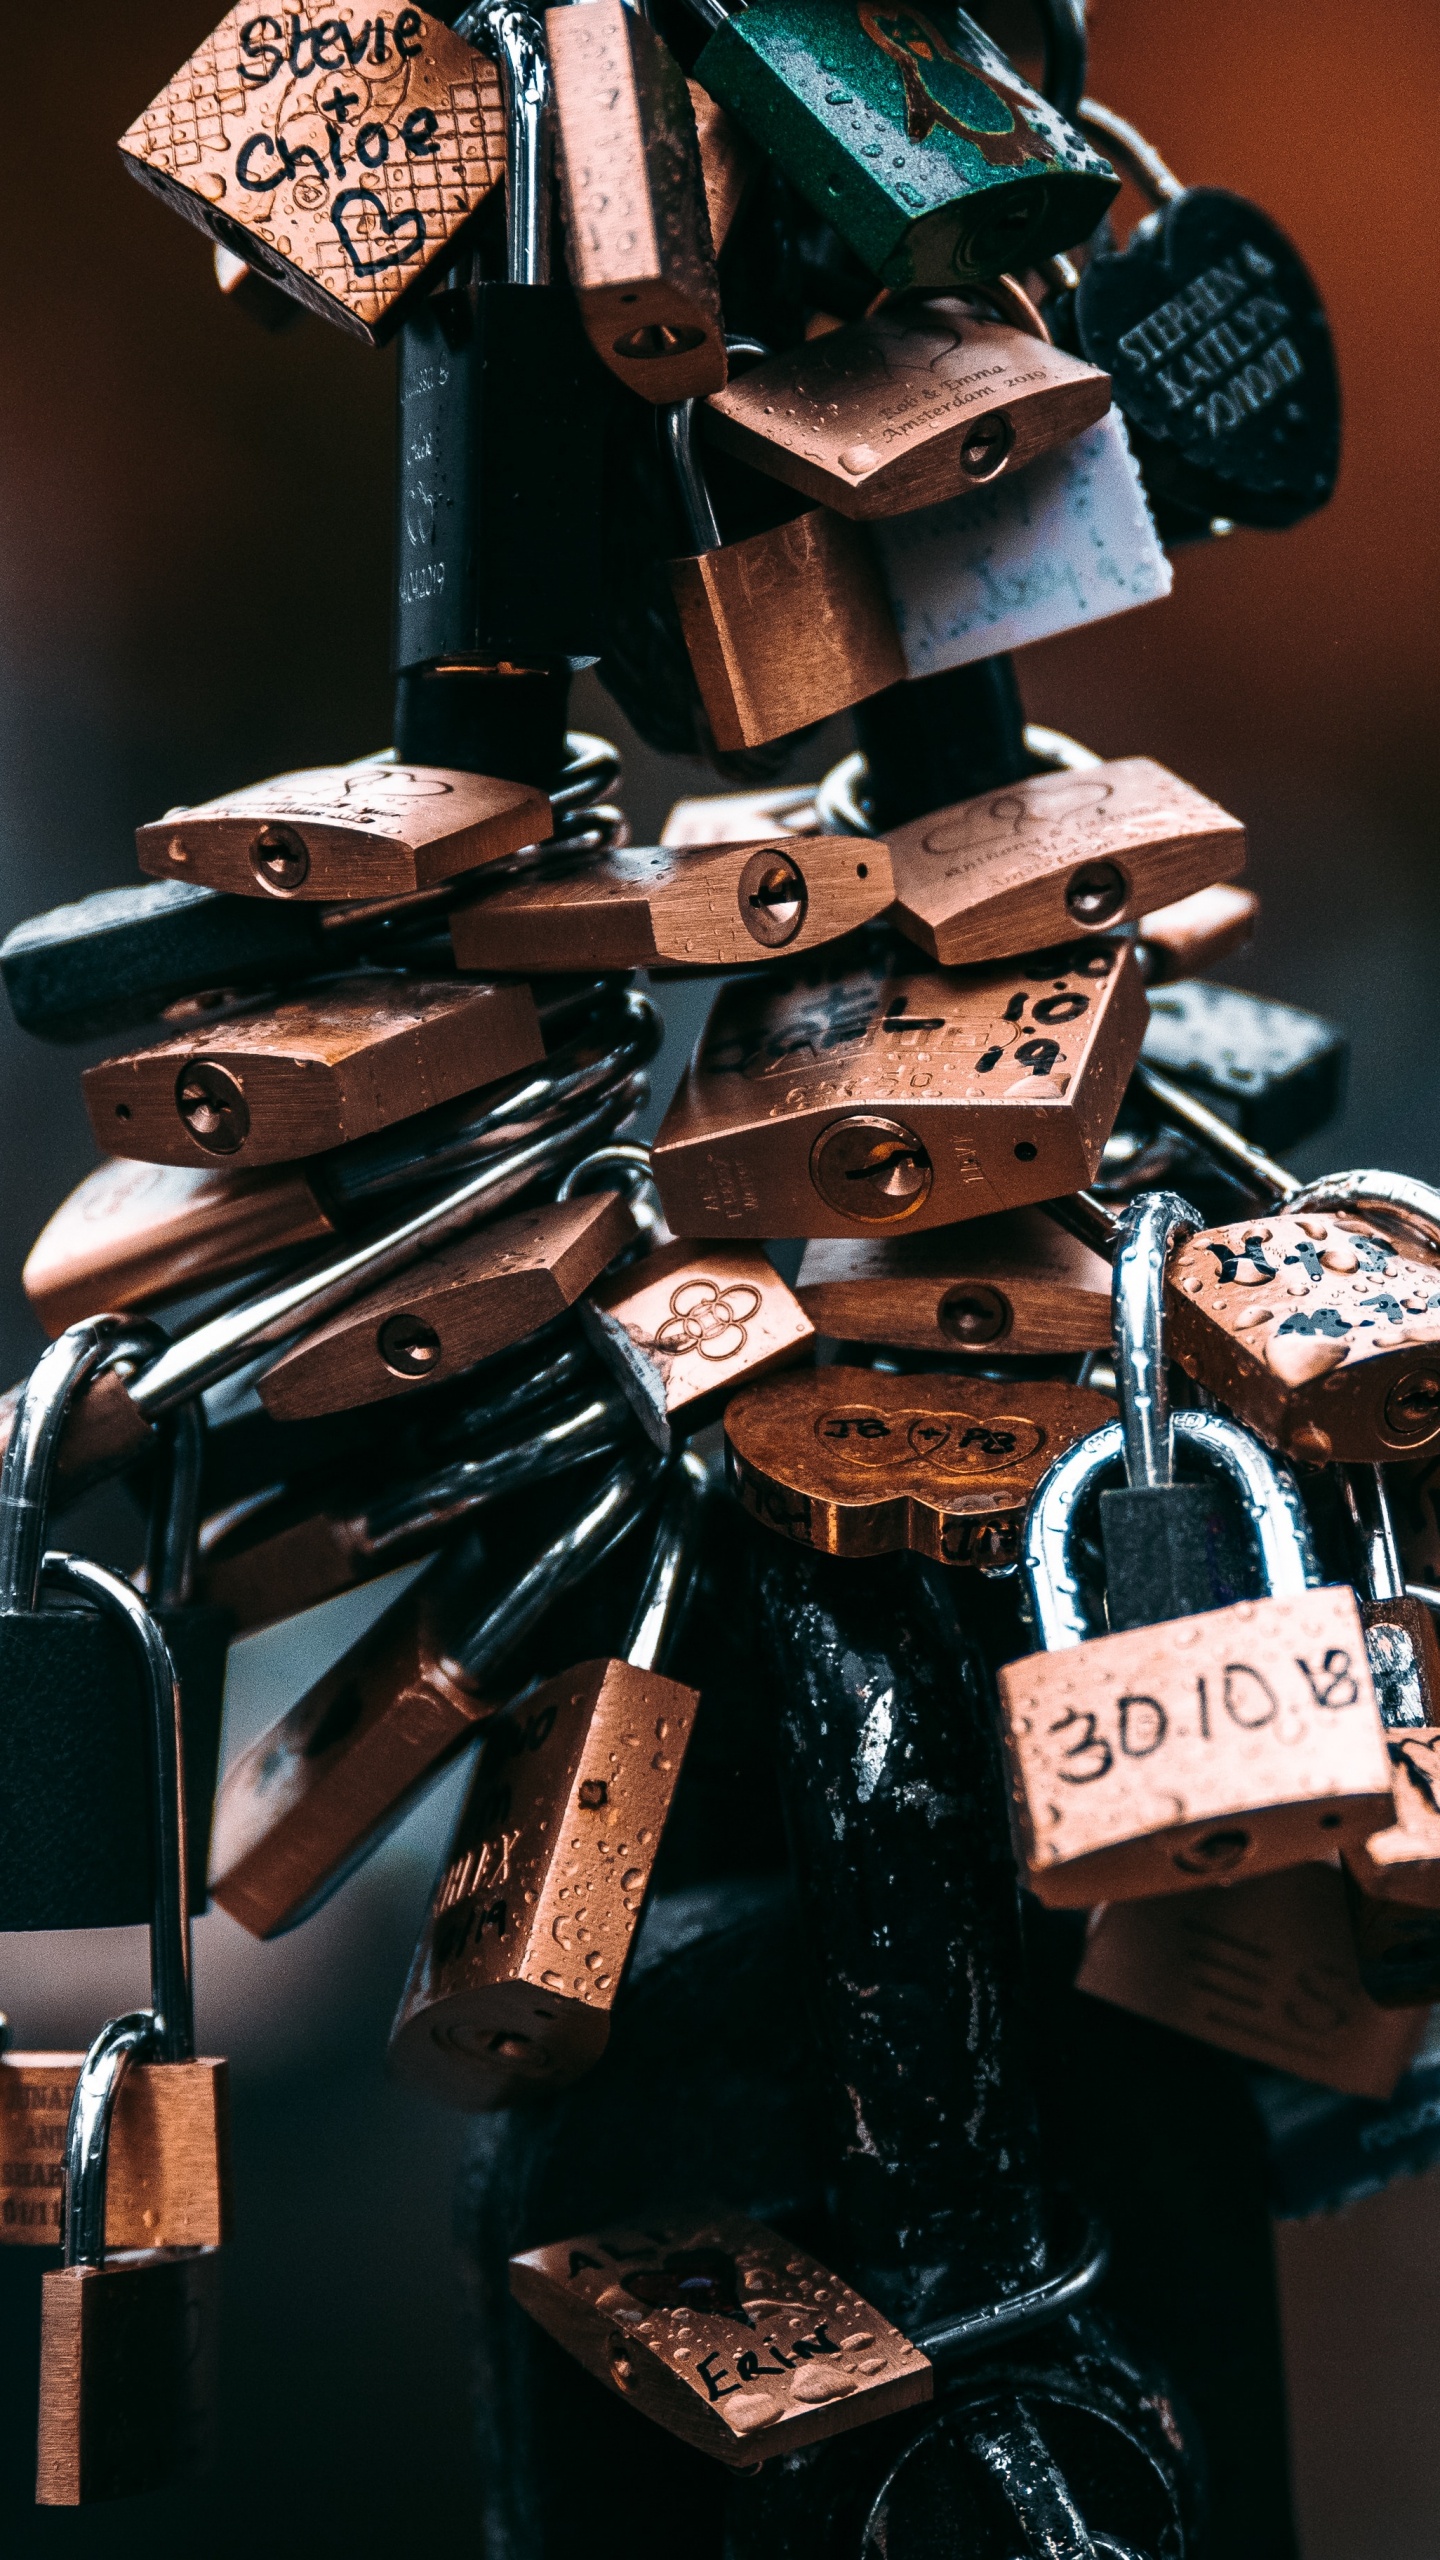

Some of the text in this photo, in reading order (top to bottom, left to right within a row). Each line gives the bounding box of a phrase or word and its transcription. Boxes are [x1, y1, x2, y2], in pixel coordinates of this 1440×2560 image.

[236, 8, 422, 83] Stevie
[322, 86, 360, 123] +
[236, 106, 441, 192] Chloe
[1117, 254, 1249, 374] STEPHEN
[882, 365, 1048, 445] Amsterdam 2019
[939, 364, 1008, 395] Emma
[823, 1418, 891, 1439] JB
